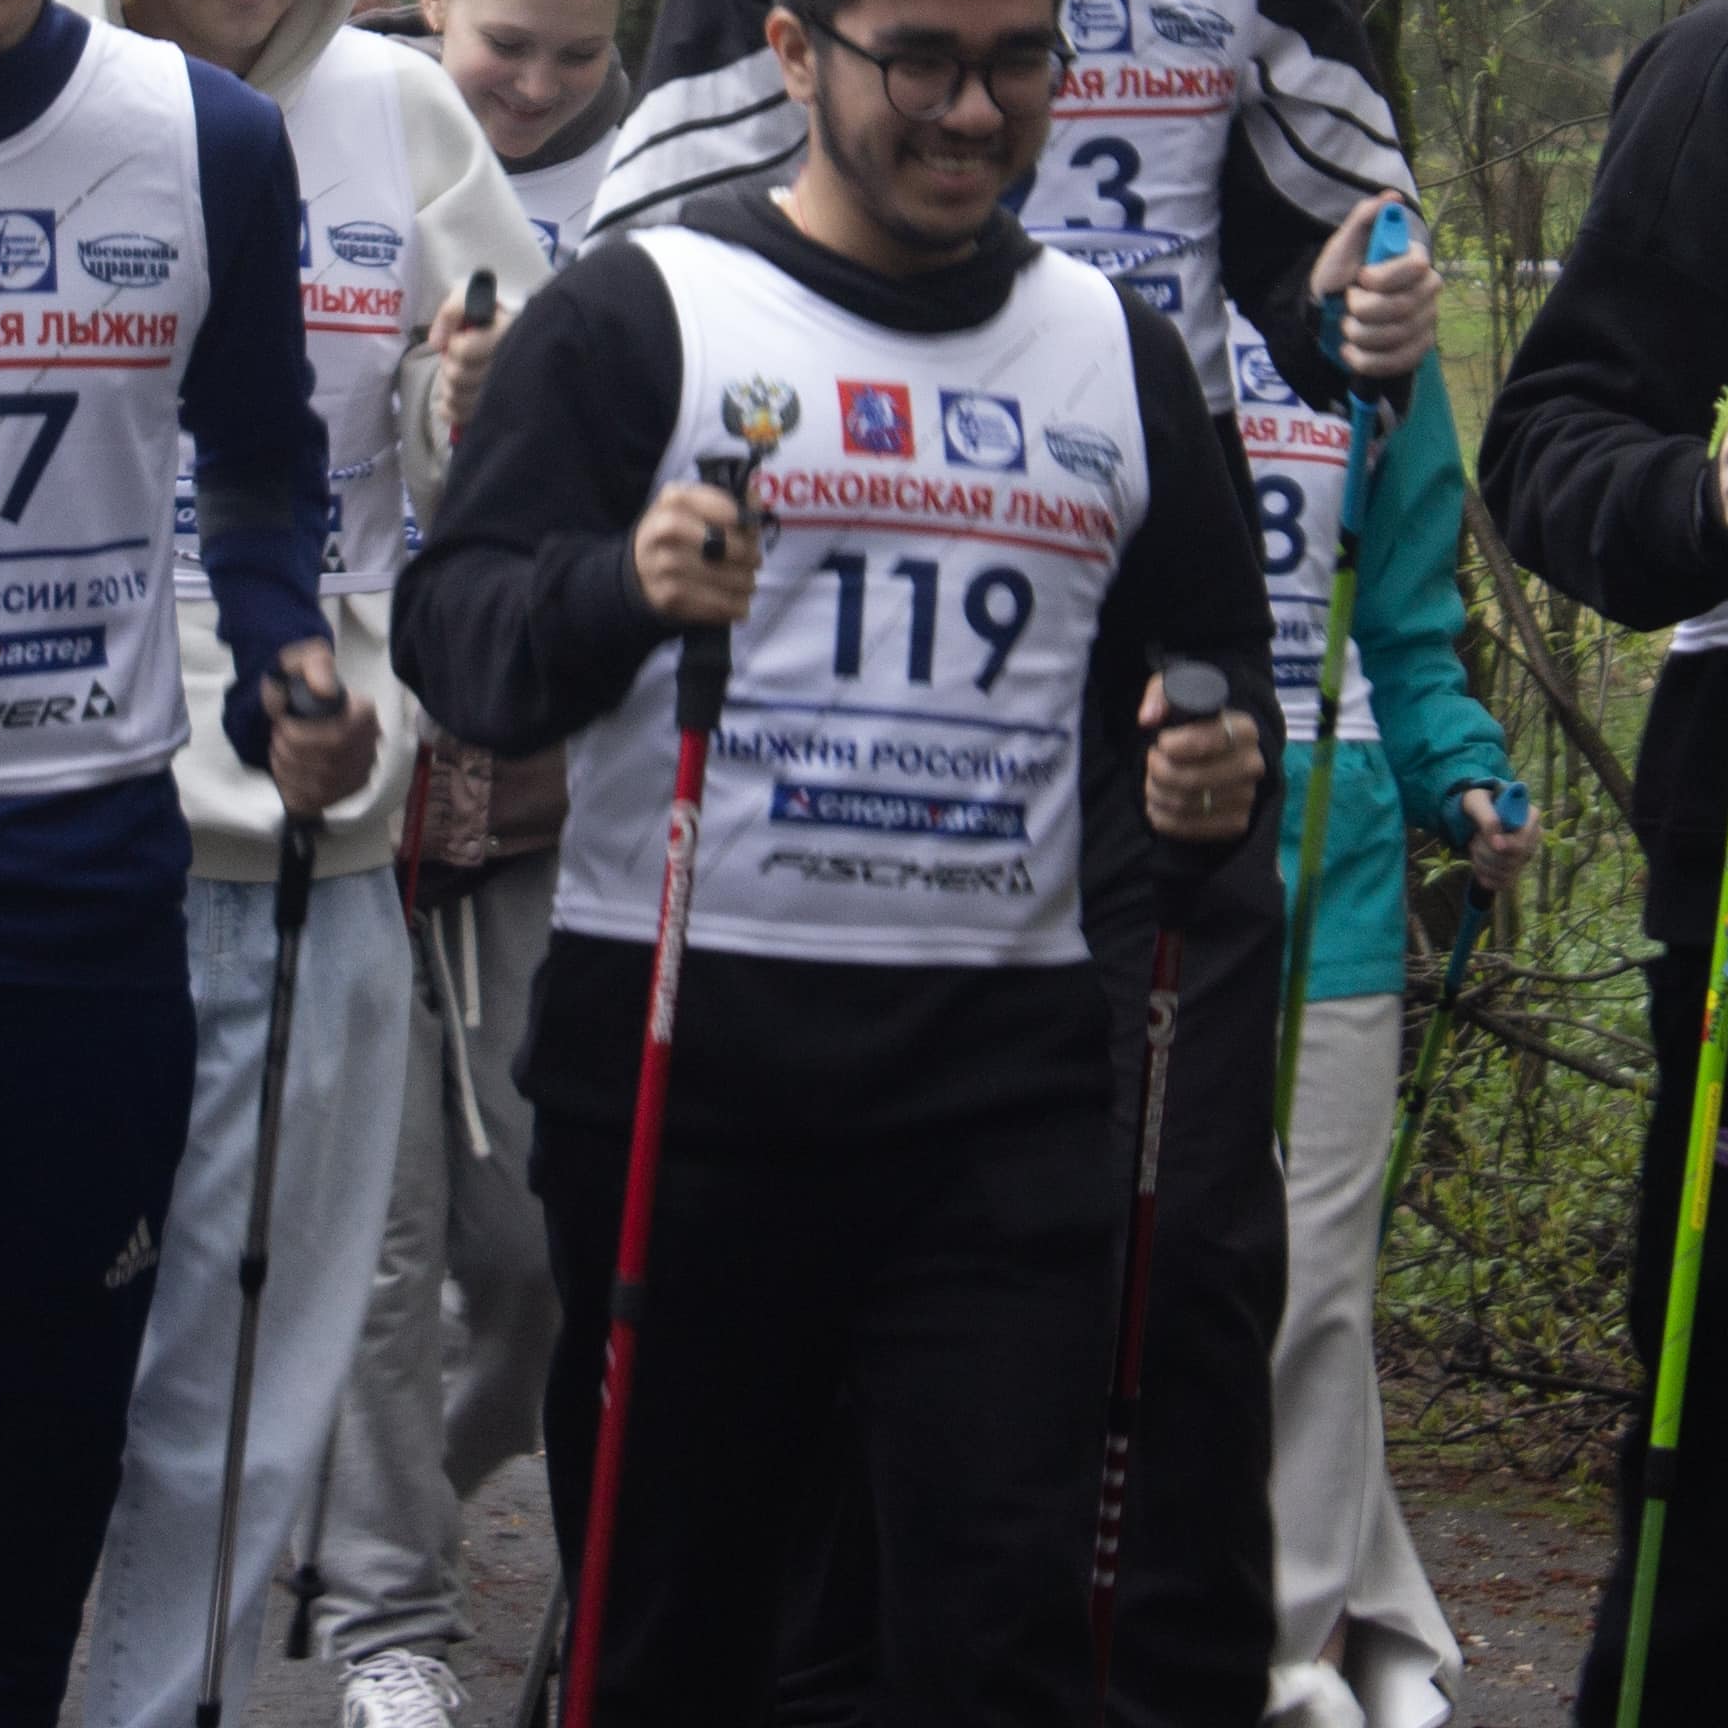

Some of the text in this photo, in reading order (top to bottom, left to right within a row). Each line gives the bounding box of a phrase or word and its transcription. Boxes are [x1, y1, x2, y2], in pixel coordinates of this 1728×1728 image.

[37, 308, 178, 348] ЛЫЖНЯ
[1288, 420, 1351, 450] ЛЫЖ
[752, 469, 993, 520] ОСКОВСКАЯ
[820, 549, 1035, 695] 119
